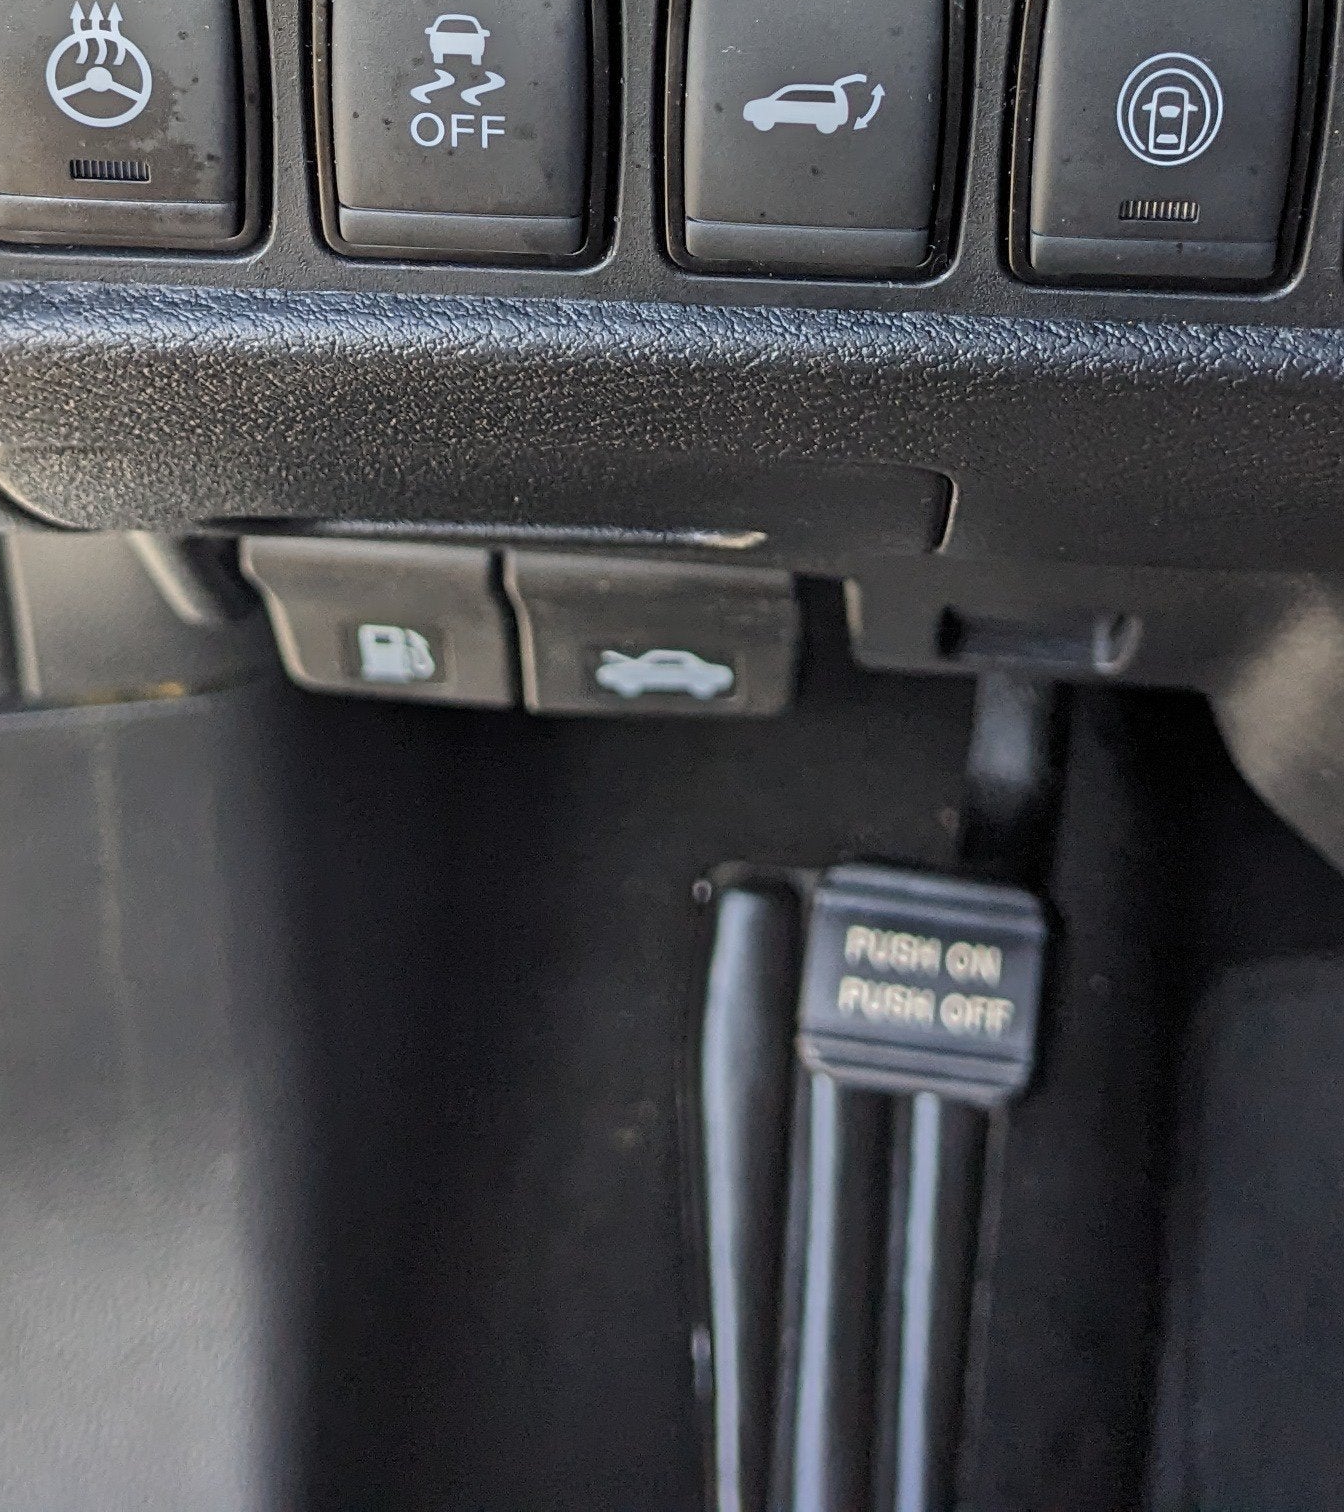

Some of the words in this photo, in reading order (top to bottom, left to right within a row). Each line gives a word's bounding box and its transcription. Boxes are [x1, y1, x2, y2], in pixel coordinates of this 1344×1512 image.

[410, 112, 506, 149] OFF
[844, 925, 941, 974] PUSH
[945, 941, 1003, 987] ON
[839, 976, 937, 1025] PUSH
[939, 994, 1016, 1037] OFF
